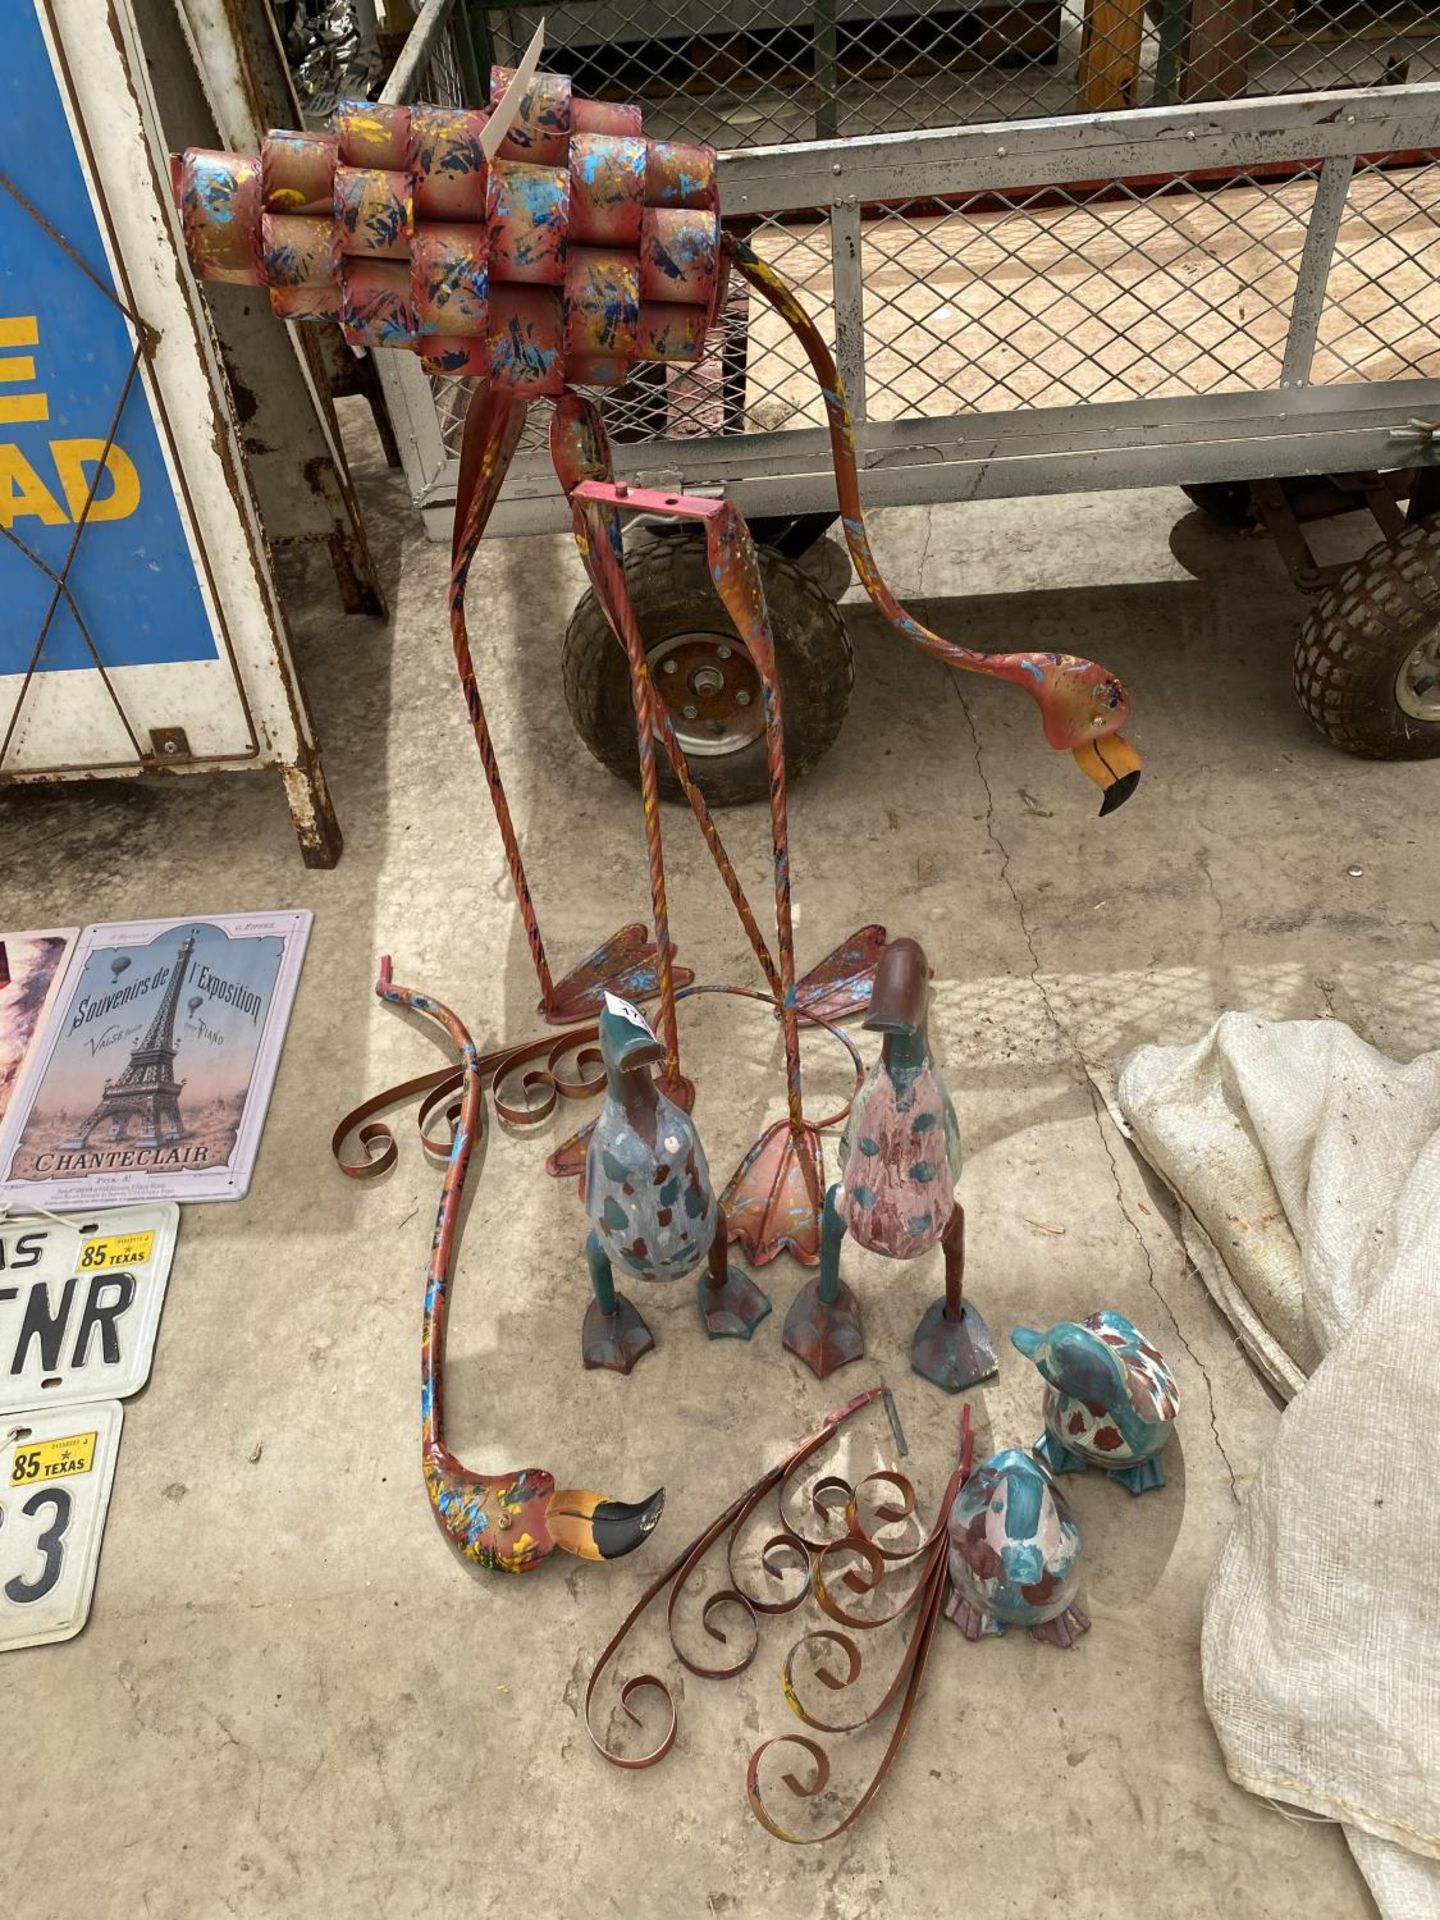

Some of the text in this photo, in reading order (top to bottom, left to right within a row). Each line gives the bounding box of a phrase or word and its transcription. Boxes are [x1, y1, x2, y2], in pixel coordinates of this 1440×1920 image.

[70, 977, 151, 1037] Souvenirs
[151, 967, 170, 990] de
[35, 1146, 209, 1172] CHANTECLAIR
[81, 1244, 144, 1267] 85 TEXAS
[0, 1272, 137, 1375] NR
[12, 1451, 84, 1481] 85 TEXAS
